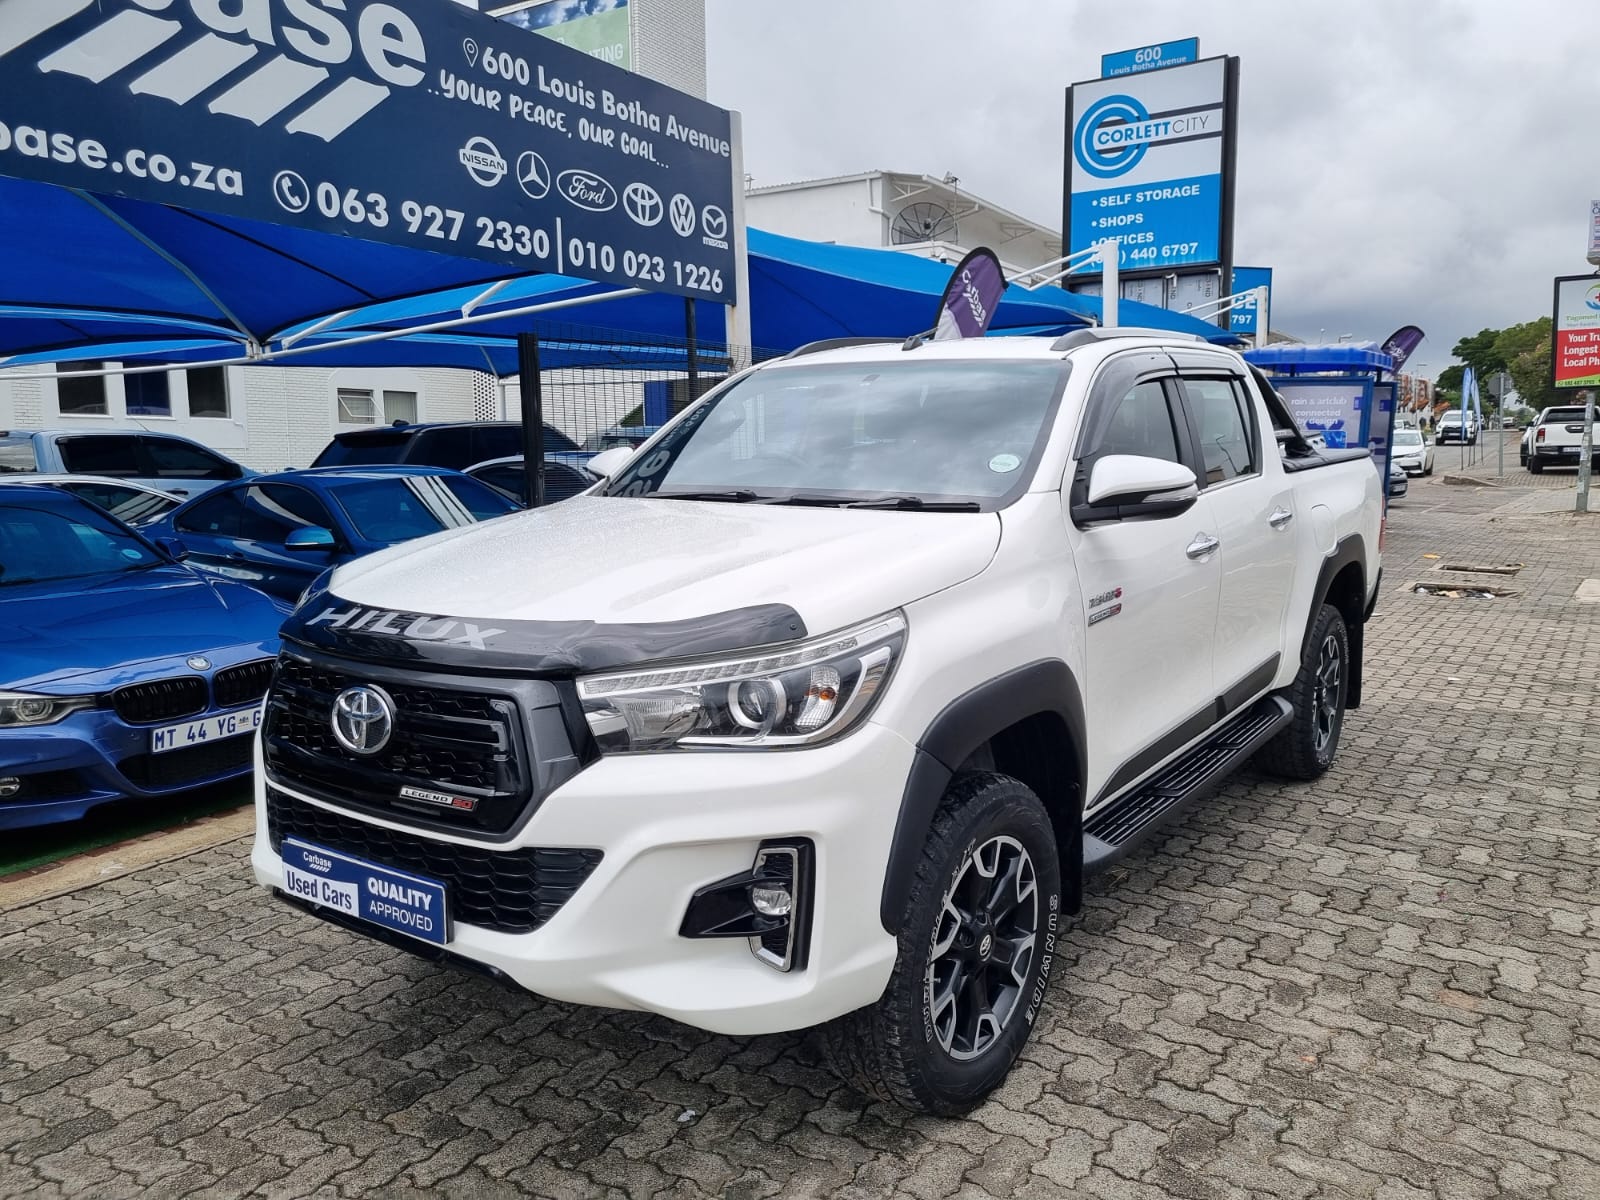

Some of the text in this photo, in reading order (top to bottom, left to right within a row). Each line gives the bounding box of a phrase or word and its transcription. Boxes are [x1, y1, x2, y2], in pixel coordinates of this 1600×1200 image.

[131, 0, 427, 87] ase
[588, 43, 624, 62] TING
[1110, 55, 1187, 76] Louis Botha Avenue
[1134, 46, 1162, 64] 600
[482, 46, 731, 158] 600 Louis Botha Avenue
[509, 95, 573, 139] PEACE,
[578, 117, 615, 148] OUR
[462, 152, 505, 171] NISSAN
[568, 174, 606, 205] Ford
[1099, 185, 1200, 208] SELF STORAGE
[317, 182, 550, 259] 063 927 2330
[1099, 213, 1144, 228] SHOPS
[1130, 246, 1158, 260] 440
[1161, 242, 1199, 258] 6797
[568, 237, 724, 294] 010 023 1226
[1230, 314, 1253, 324] 797
[1568, 333, 1588, 343] Your
[1564, 345, 1598, 357] Longest
[1564, 356, 1600, 367] Local Ph
[1295, 409, 1341, 417] connected
[305, 606, 507, 650] HILUX
[154, 728, 177, 750] MT
[186, 722, 207, 742] 44
[217, 716, 236, 736] YG
[405, 788, 449, 802] LEGEND
[303, 850, 332, 868] Carbase
[286, 868, 353, 911] Used Cars
[367, 875, 433, 911] QUALITY
[368, 899, 433, 933] APPROVED
[1024, 893, 1060, 1027] SUNWIDE
